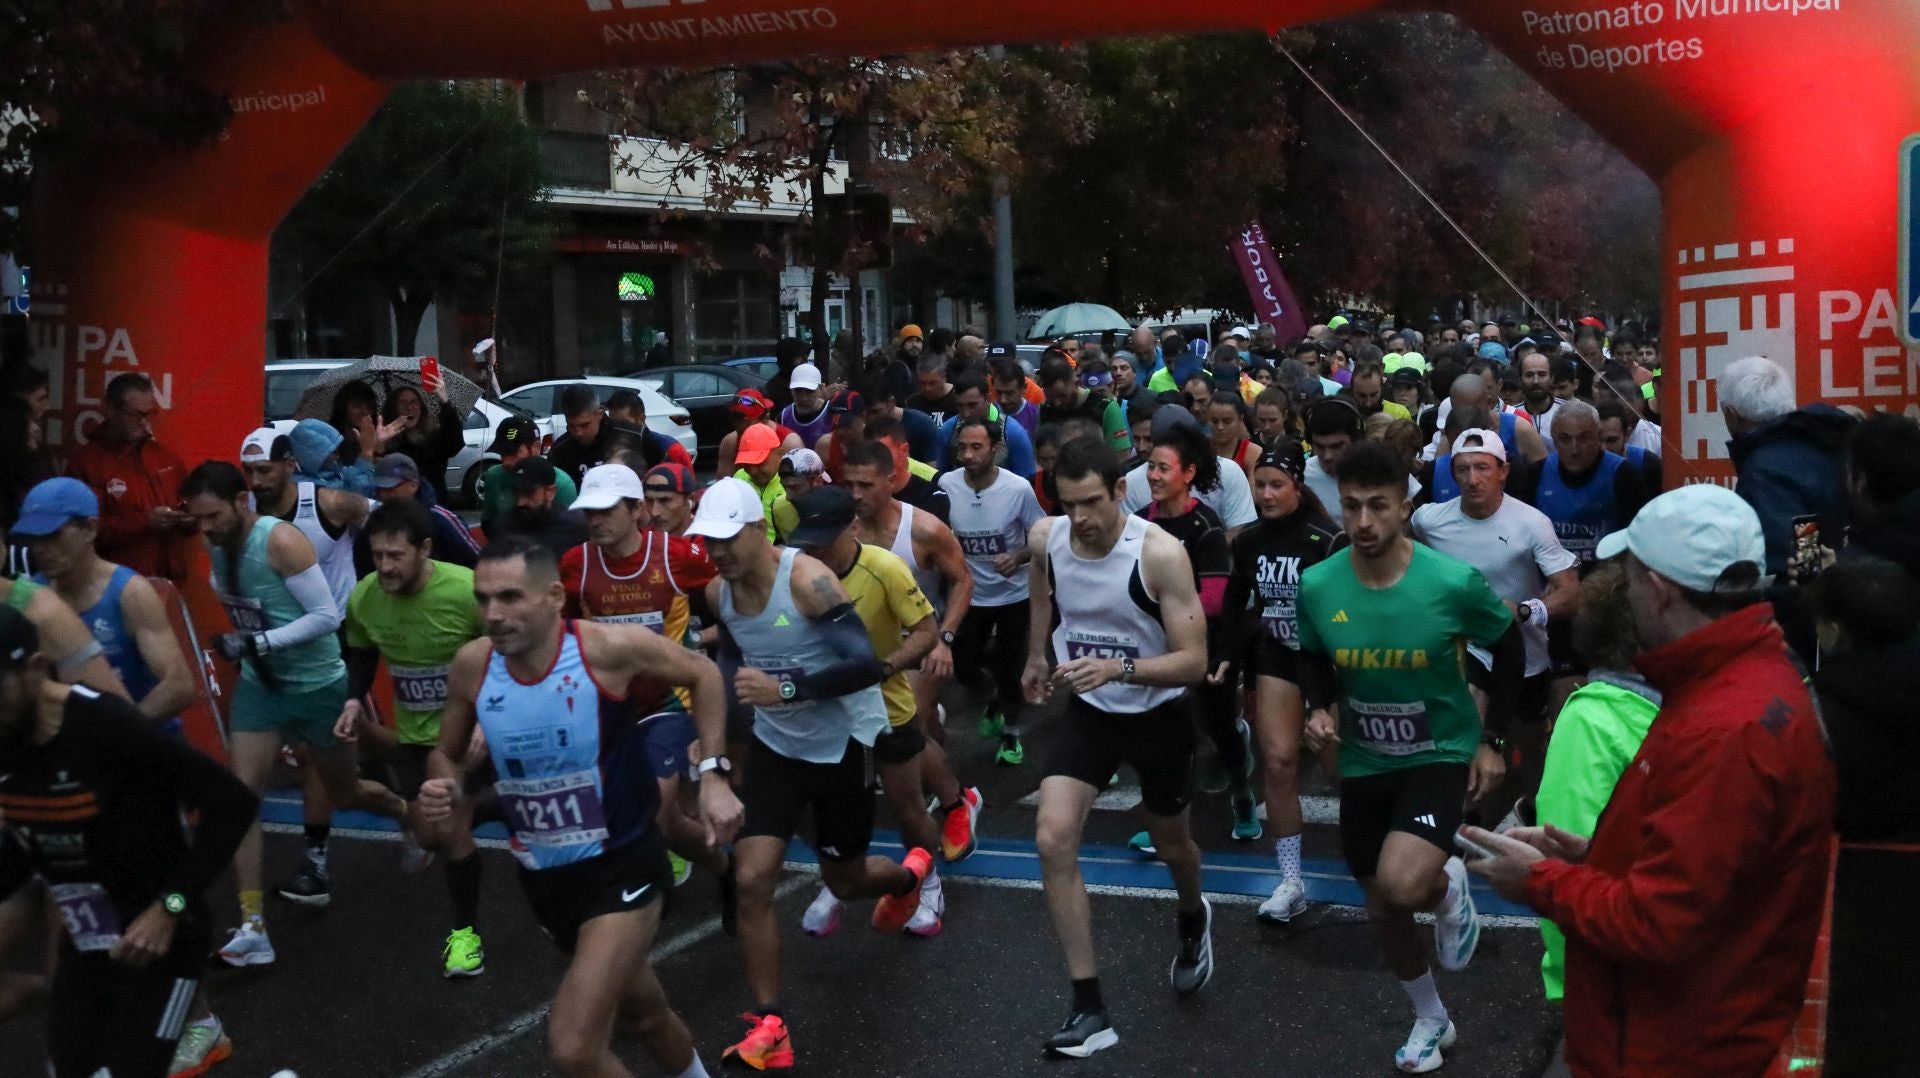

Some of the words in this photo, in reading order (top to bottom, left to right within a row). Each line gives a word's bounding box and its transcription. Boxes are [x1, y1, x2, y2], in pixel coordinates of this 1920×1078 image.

[604, 7, 837, 44] AYUNTAMIENTO
[1521, 1, 1664, 36] Patronato
[1536, 44, 1566, 69] de
[1568, 36, 1704, 73] Deportes
[233, 86, 326, 113] unicipal
[1819, 288, 1898, 341] PA
[78, 325, 140, 366] PA
[963, 537, 998, 553] 1214
[1256, 555, 1301, 584] 3x7K
[602, 595, 618, 604] DE
[620, 592, 652, 601] TORO
[611, 583, 641, 593] VINO
[1086, 633, 1119, 644] PALENCIA
[400, 678, 449, 700] 1059
[1366, 705, 1403, 713] PALENCIA
[1358, 715, 1416, 741] 1010
[522, 779, 567, 793] PALENCIA
[514, 793, 583, 830] 1211
